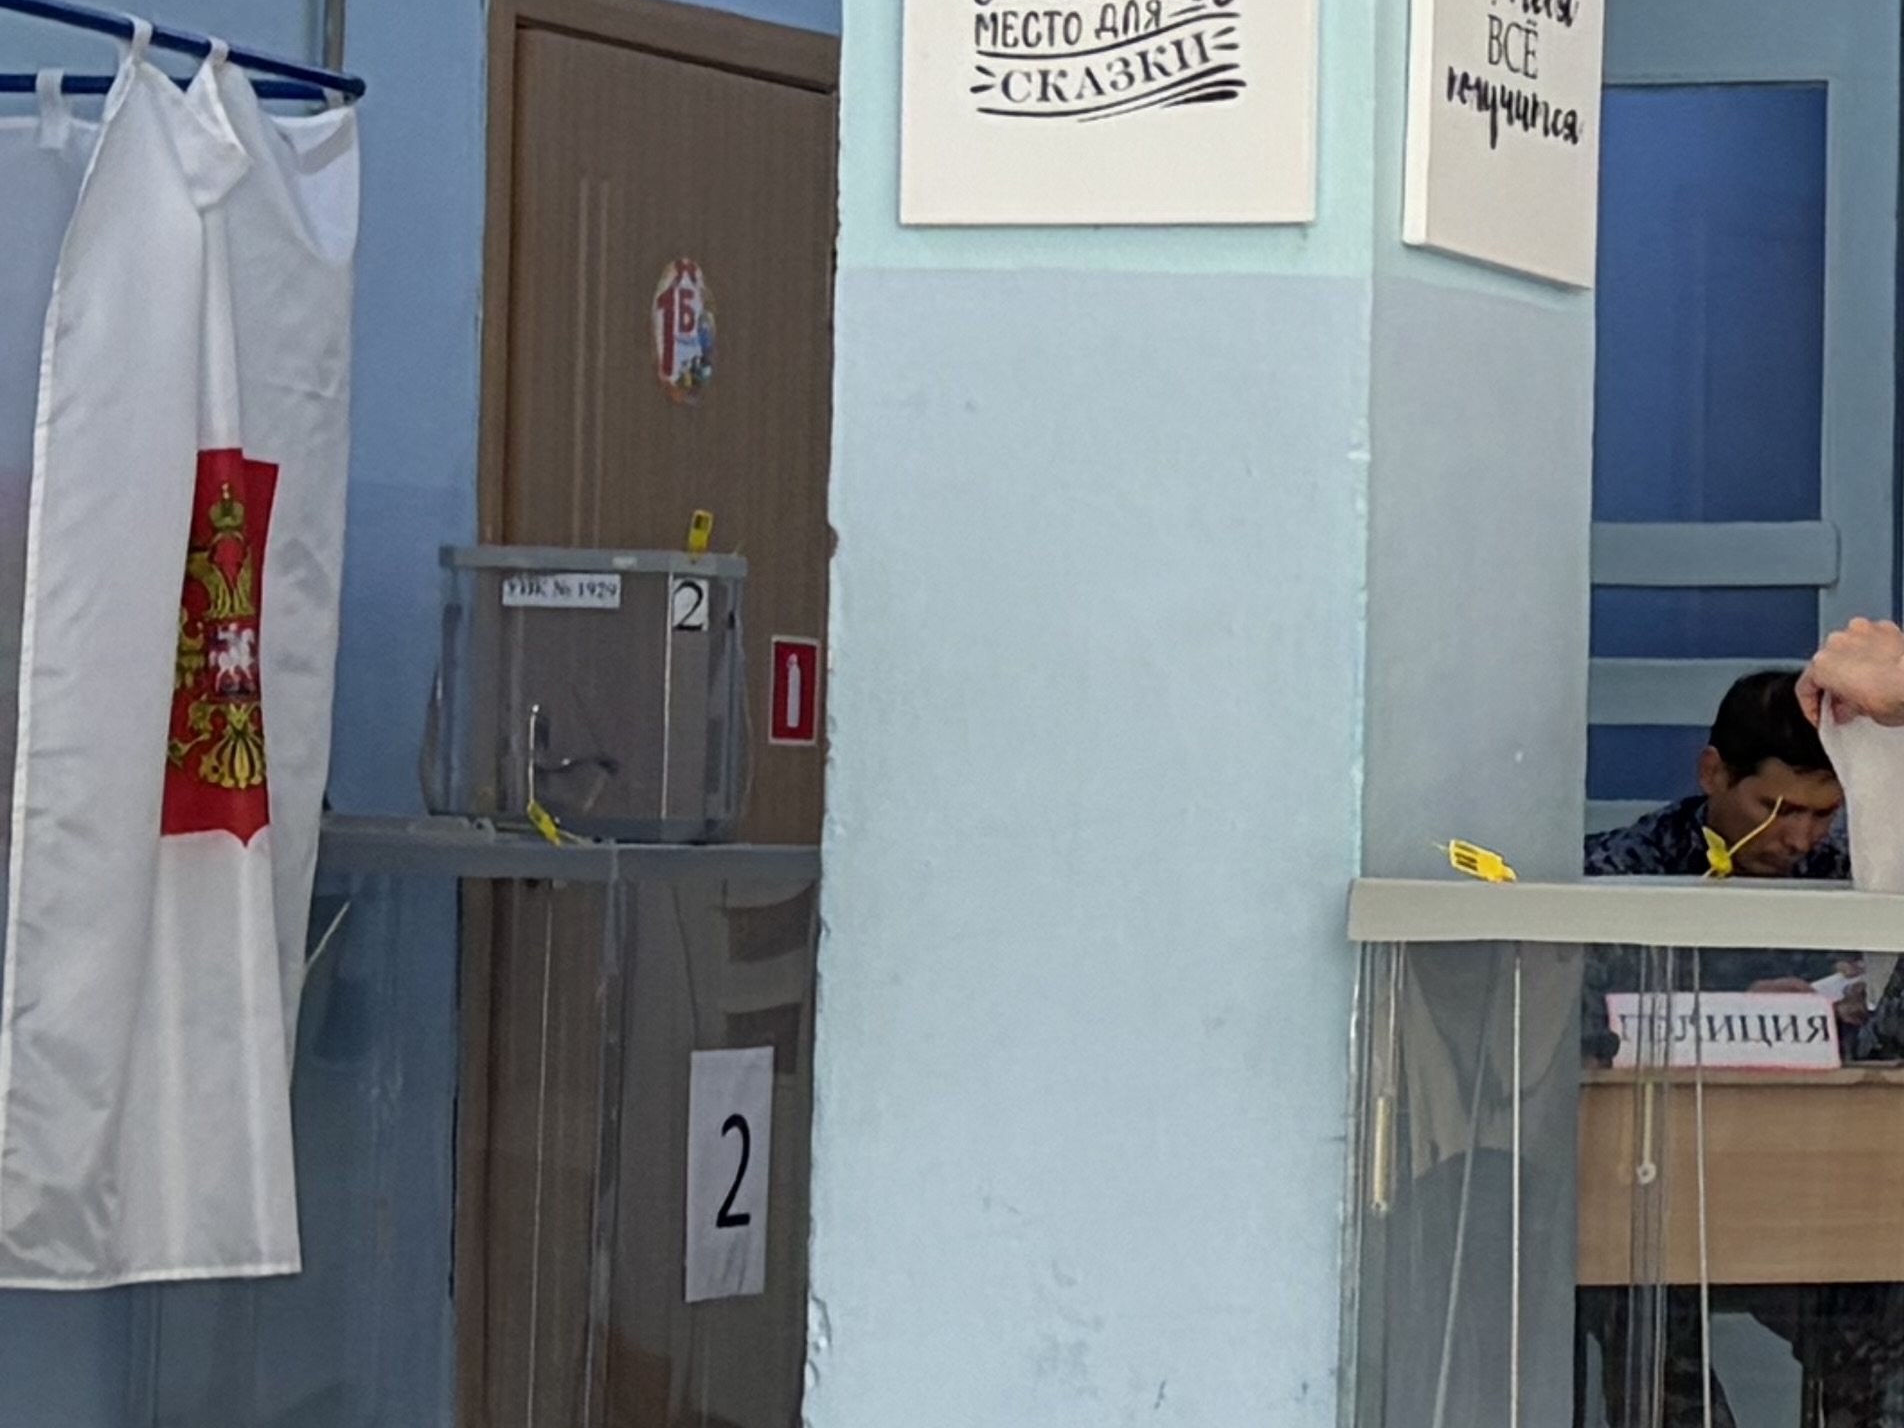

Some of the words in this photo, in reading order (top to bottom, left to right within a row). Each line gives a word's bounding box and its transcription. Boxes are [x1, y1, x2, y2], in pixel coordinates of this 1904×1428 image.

[974, 10, 1083, 48] МЕСТО
[1001, 31, 1212, 104] СКАЗКИ
[672, 580, 704, 631] 2
[716, 1113, 751, 1228] 2
